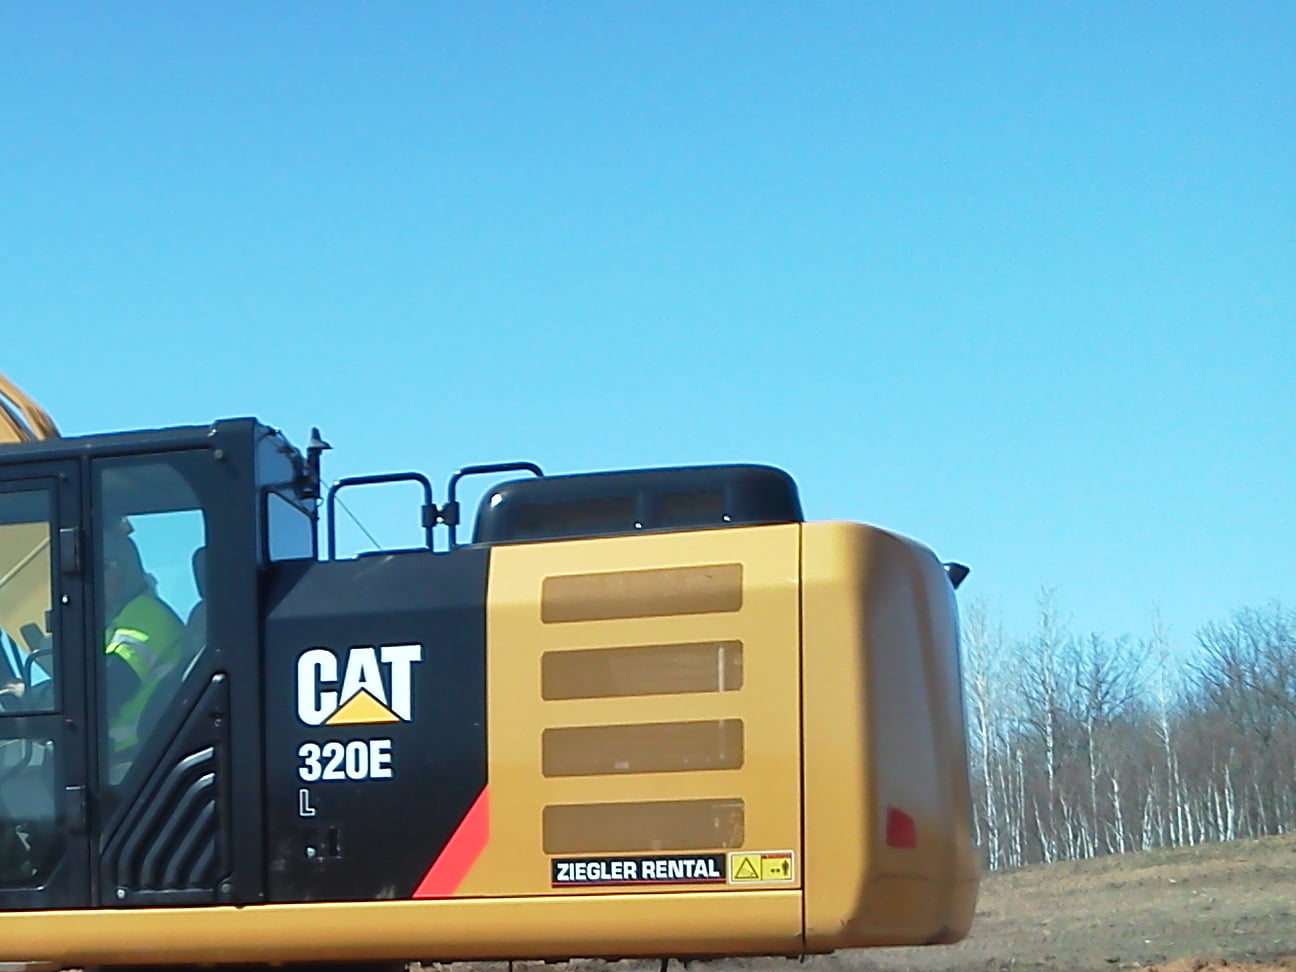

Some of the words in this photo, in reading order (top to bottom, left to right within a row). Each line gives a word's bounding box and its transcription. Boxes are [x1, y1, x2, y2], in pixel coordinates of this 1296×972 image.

[297, 644, 422, 726] CAT
[298, 739, 393, 782] 320E
[299, 788, 316, 816] L
[556, 861, 637, 881] ZIEGLER
[642, 859, 720, 880] RENTAL
